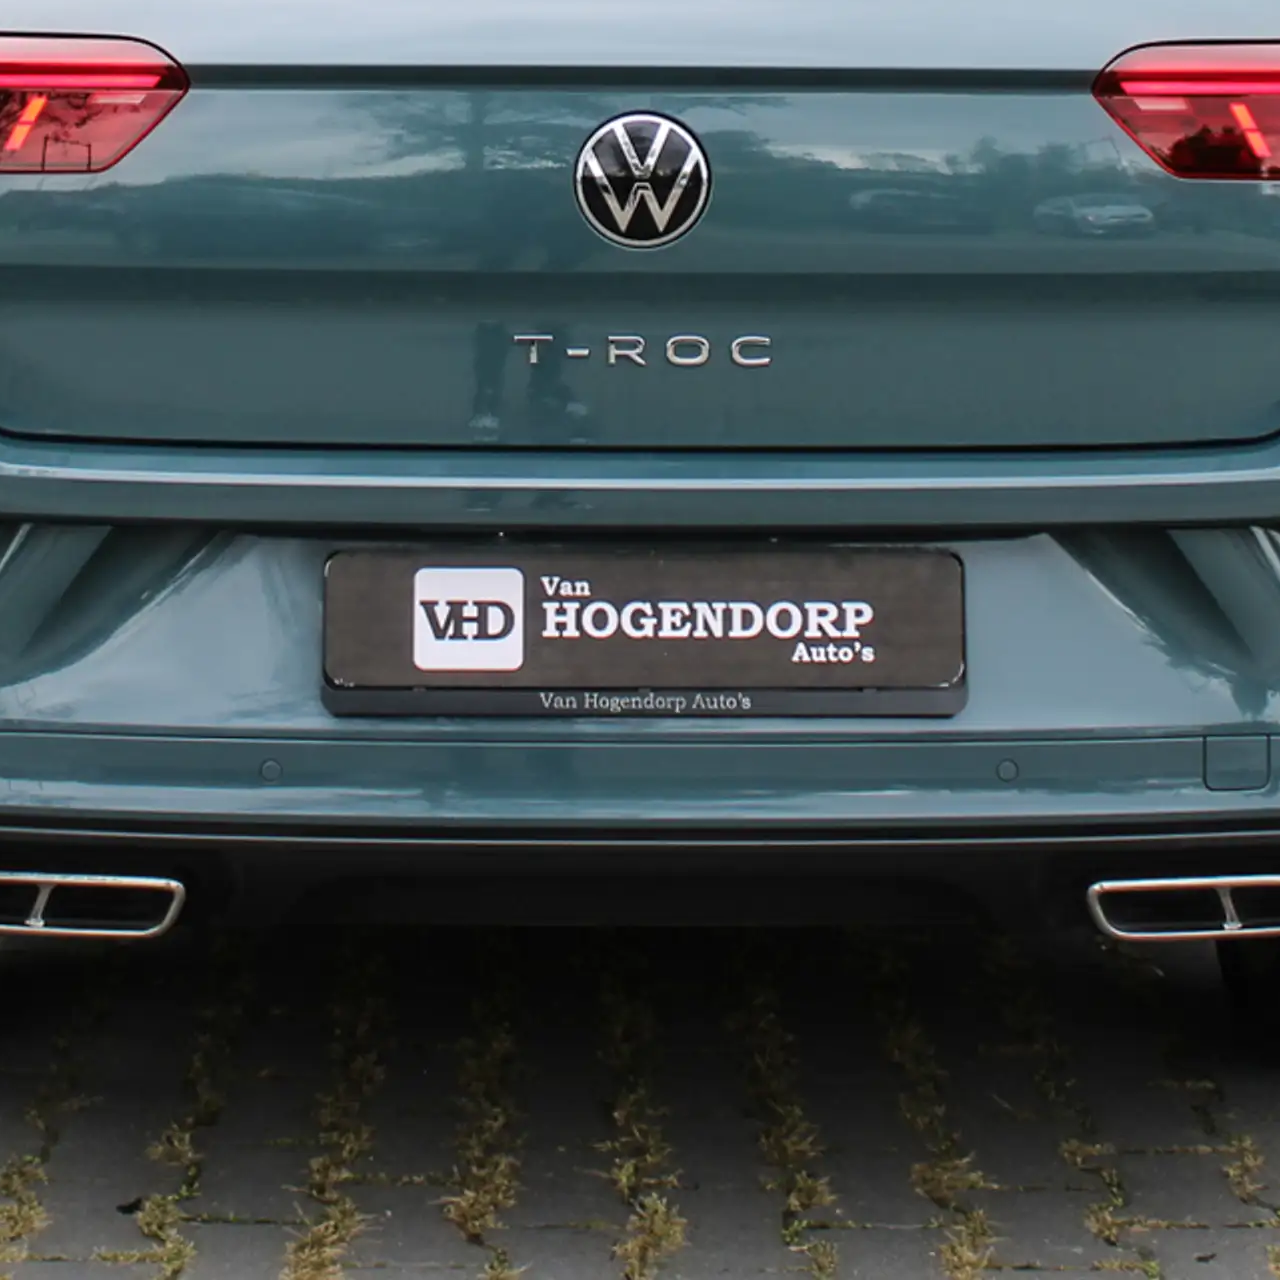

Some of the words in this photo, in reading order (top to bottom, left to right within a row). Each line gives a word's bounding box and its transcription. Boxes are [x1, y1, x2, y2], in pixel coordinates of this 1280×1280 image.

[514, 335, 771, 366] T-ROC
[541, 576, 591, 596] Van
[419, 600, 516, 641] VHD
[541, 601, 874, 638] HOGENDORP
[791, 642, 875, 662] Auto's
[540, 692, 577, 709] Van
[584, 692, 687, 712] Hogendorp
[692, 692, 752, 709] Auto's
